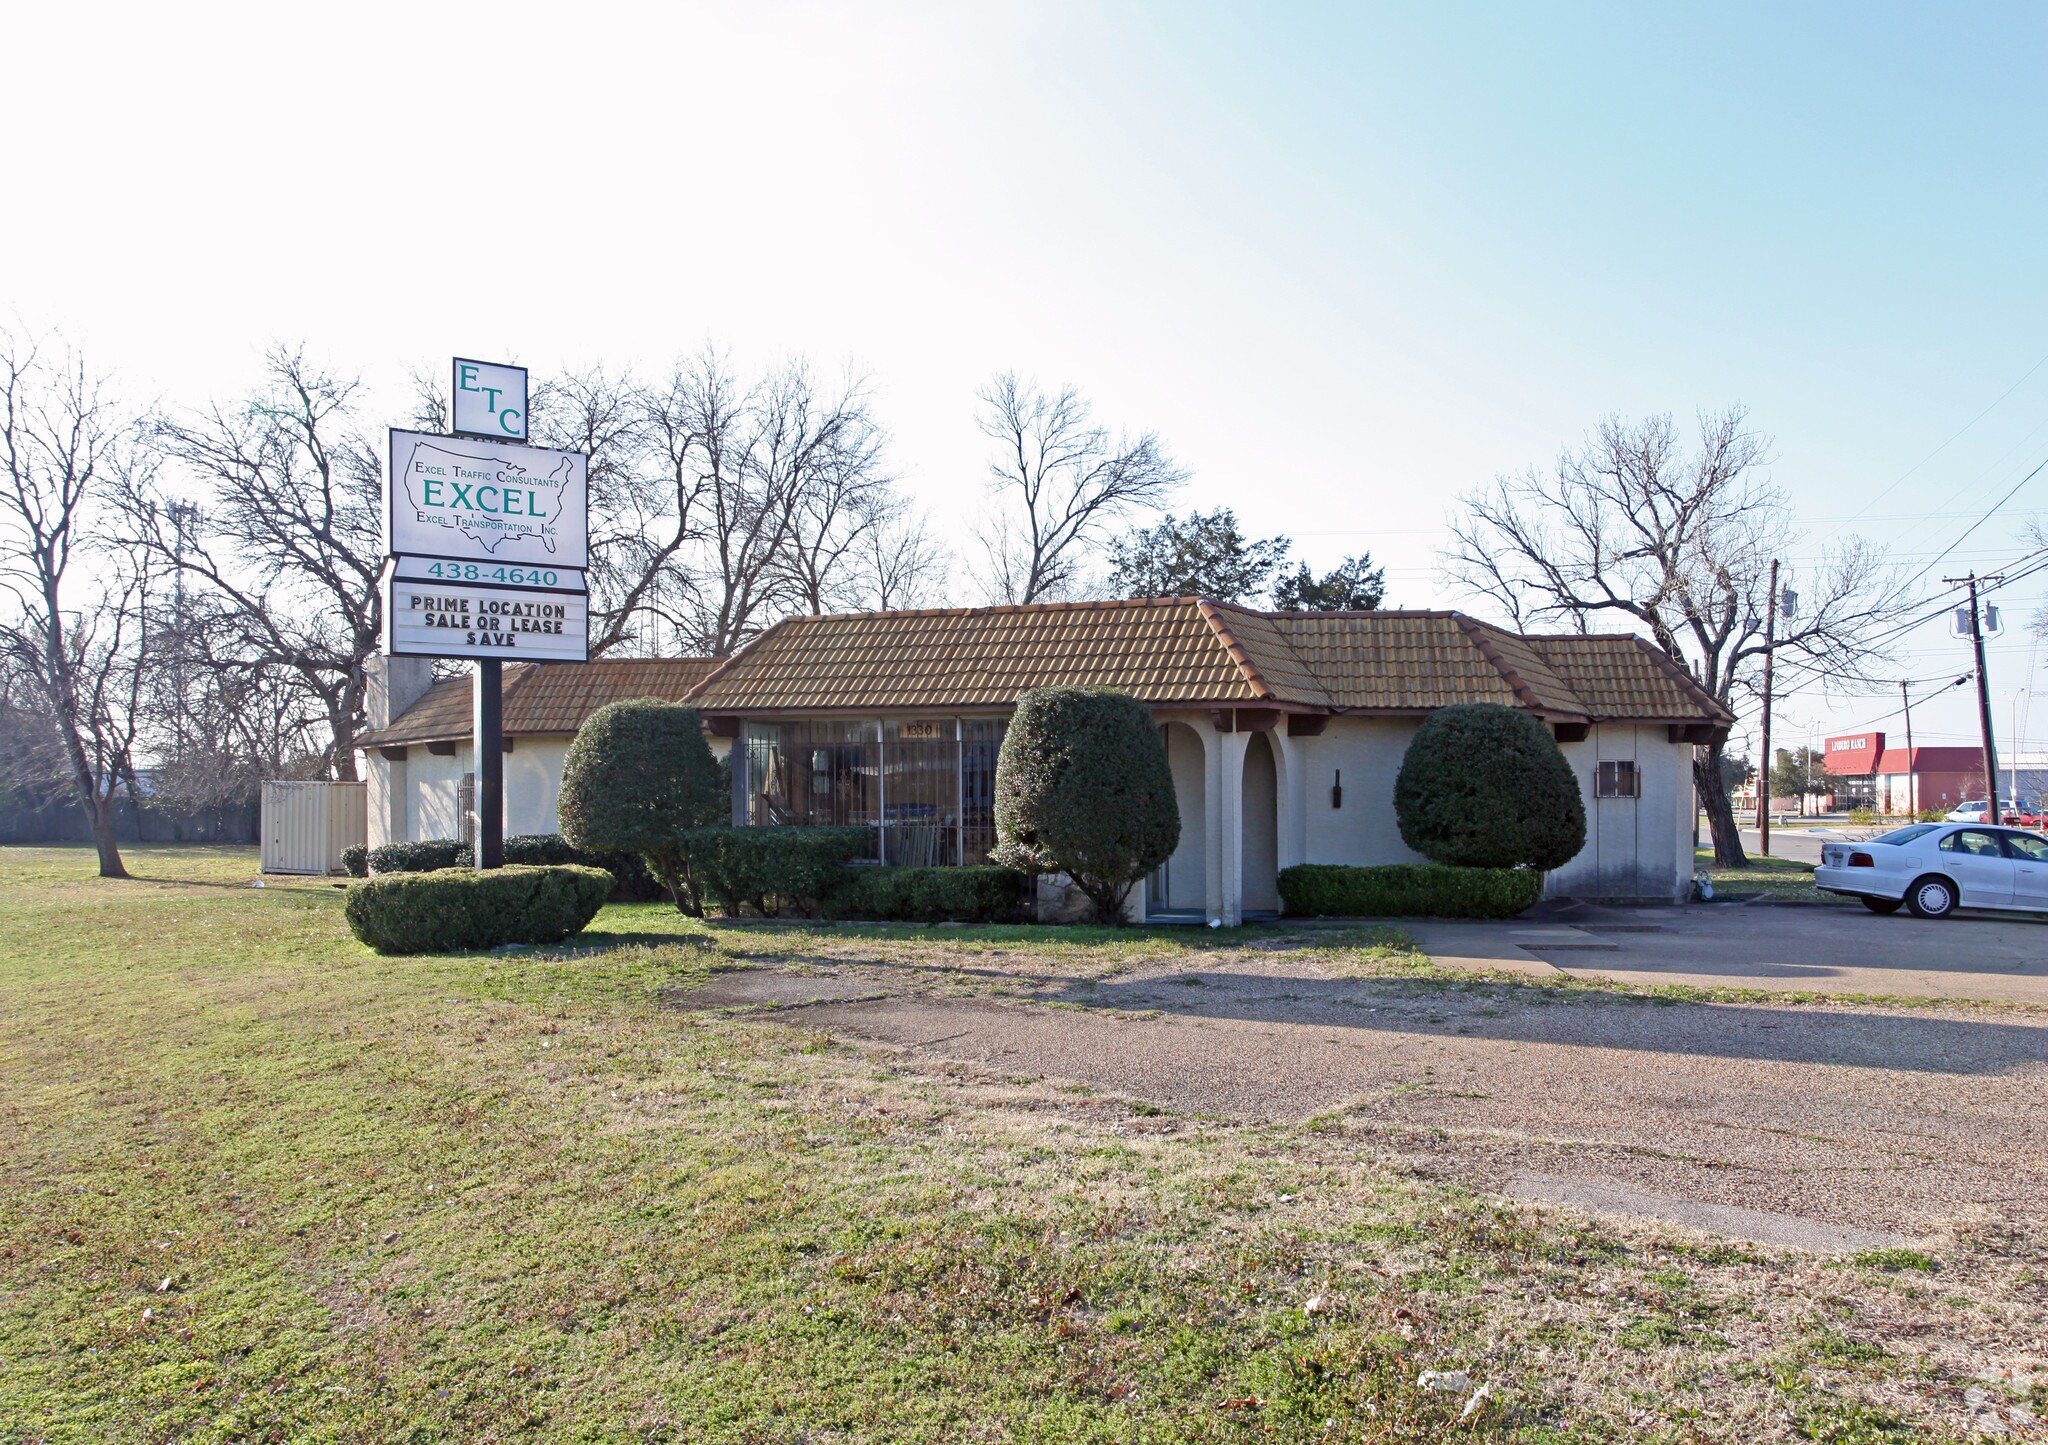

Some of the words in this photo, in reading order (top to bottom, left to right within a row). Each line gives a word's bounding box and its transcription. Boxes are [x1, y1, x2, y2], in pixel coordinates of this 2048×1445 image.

[423, 479, 547, 518] EXCEL
[427, 562, 558, 586] 438-4640
[410, 595, 470, 613] PRIME
[479, 600, 565, 618] LOCATION
[425, 613, 471, 629] SALE
[477, 616, 500, 630] OR
[511, 618, 563, 634] LEASE
[466, 631, 516, 647] SAVE
